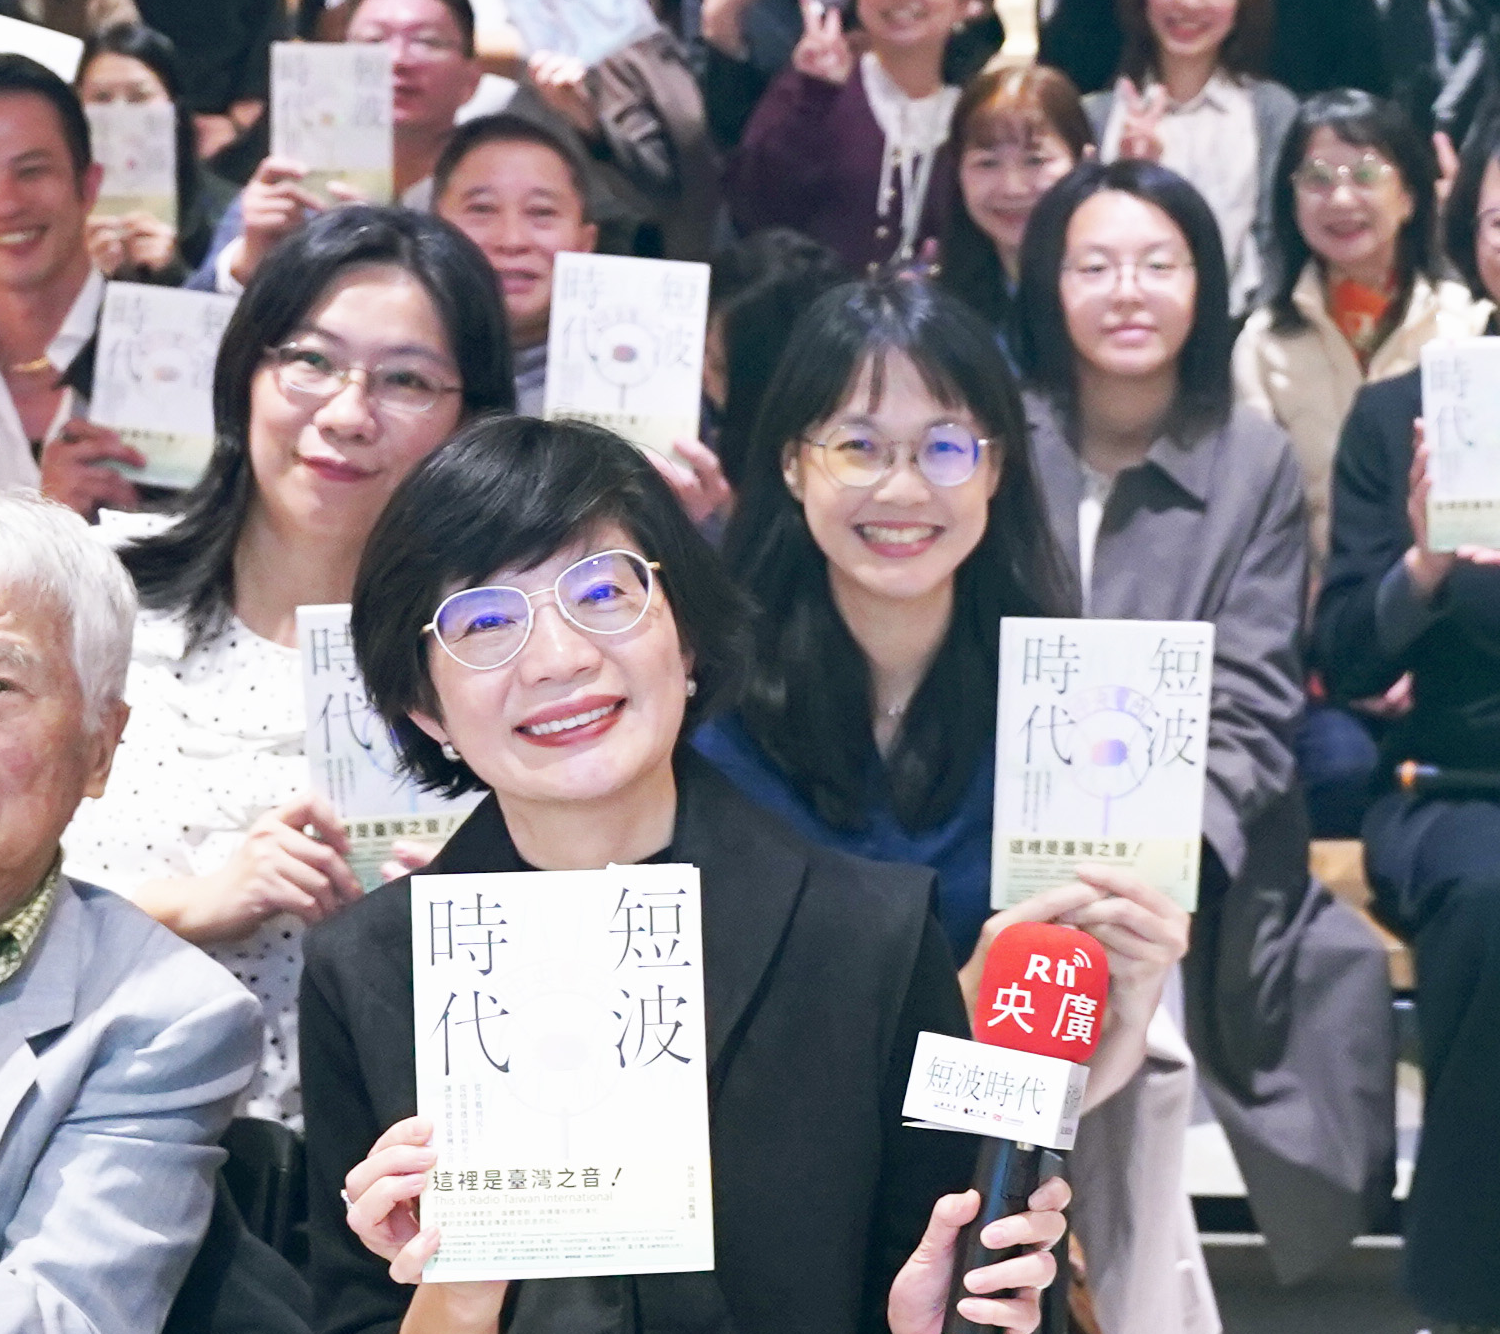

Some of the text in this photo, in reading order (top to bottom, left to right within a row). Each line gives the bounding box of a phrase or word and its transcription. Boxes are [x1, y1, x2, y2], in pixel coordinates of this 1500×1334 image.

[1018, 634, 1080, 766] 時代
[1147, 637, 1205, 767] 短波
[428, 892, 511, 1077] 時代
[609, 886, 693, 1069] 短波
[987, 982, 1098, 1045] 央廣
[925, 1056, 1047, 1116] 短波時代
[434, 1195, 456, 1206] This
[469, 1193, 500, 1205] Radio
[503, 1193, 541, 1204] Taiwan
[543, 1191, 613, 1203] International
